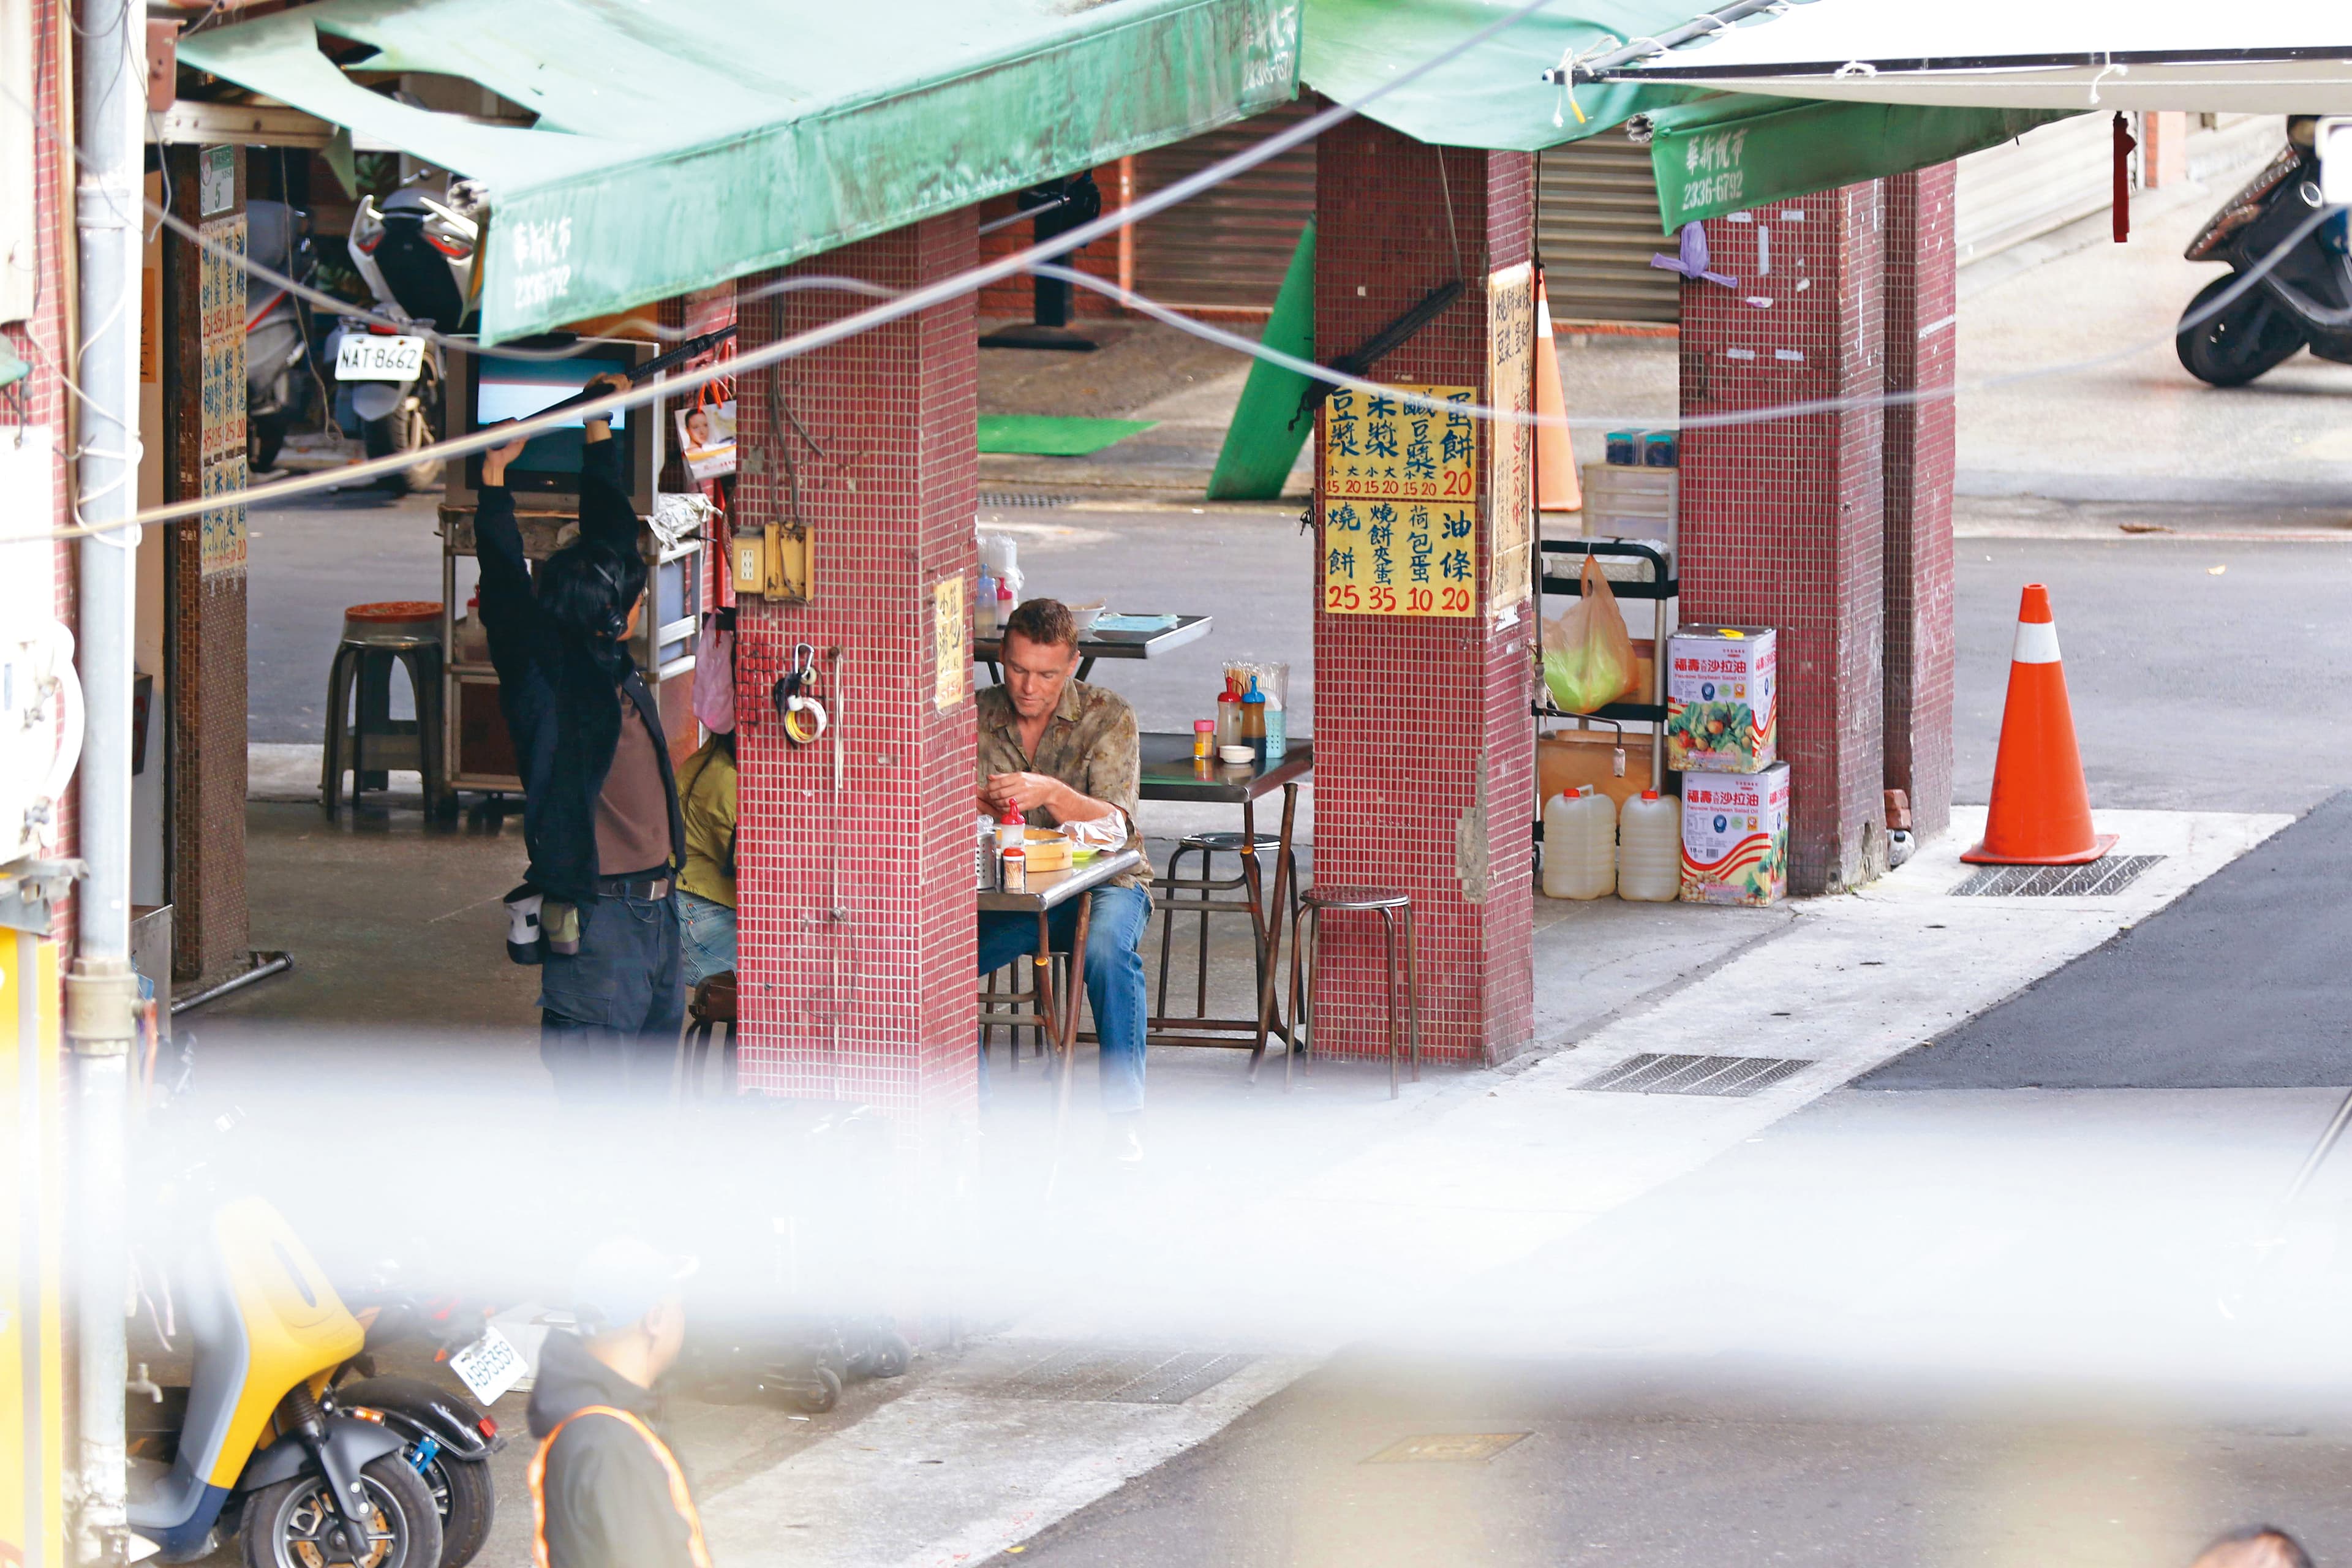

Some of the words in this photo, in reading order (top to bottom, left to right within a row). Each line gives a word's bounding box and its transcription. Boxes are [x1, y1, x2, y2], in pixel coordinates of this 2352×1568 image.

[1682, 169, 1743, 211] 2336-6792
[213, 310, 222, 333] 35
[225, 308, 233, 329] 10
[340, 348, 417, 369] NAT-8662
[225, 421, 235, 442] 25
[236, 418, 246, 439] 20
[1327, 388, 1360, 457] 豆漿
[1365, 391, 1399, 458] 米漿
[1441, 392, 1474, 469] 蛋餅
[1329, 466, 1339, 477] 小
[1347, 466, 1360, 477] 大
[1365, 467, 1378, 478] 小
[1384, 466, 1397, 478] 大
[1404, 470, 1416, 480] 小
[1423, 470, 1435, 480] 大
[1443, 470, 1472, 496] 20
[1327, 480, 1340, 494] 15
[1345, 480, 1361, 494] 20
[1365, 480, 1379, 494] 15
[1382, 480, 1399, 494] 20
[1403, 481, 1417, 496] 15
[1421, 481, 1436, 496] 20
[1327, 501, 1361, 579] 燒餅
[1367, 501, 1398, 585] 燒餅夾蛋
[1406, 504, 1433, 584] 荷包蛋
[1440, 509, 1472, 582] 油條
[1328, 584, 1360, 611] 25
[1369, 586, 1396, 612] 35
[1406, 587, 1433, 612] 10
[1441, 587, 1470, 612] 20
[466, 1341, 514, 1390] AB95359
